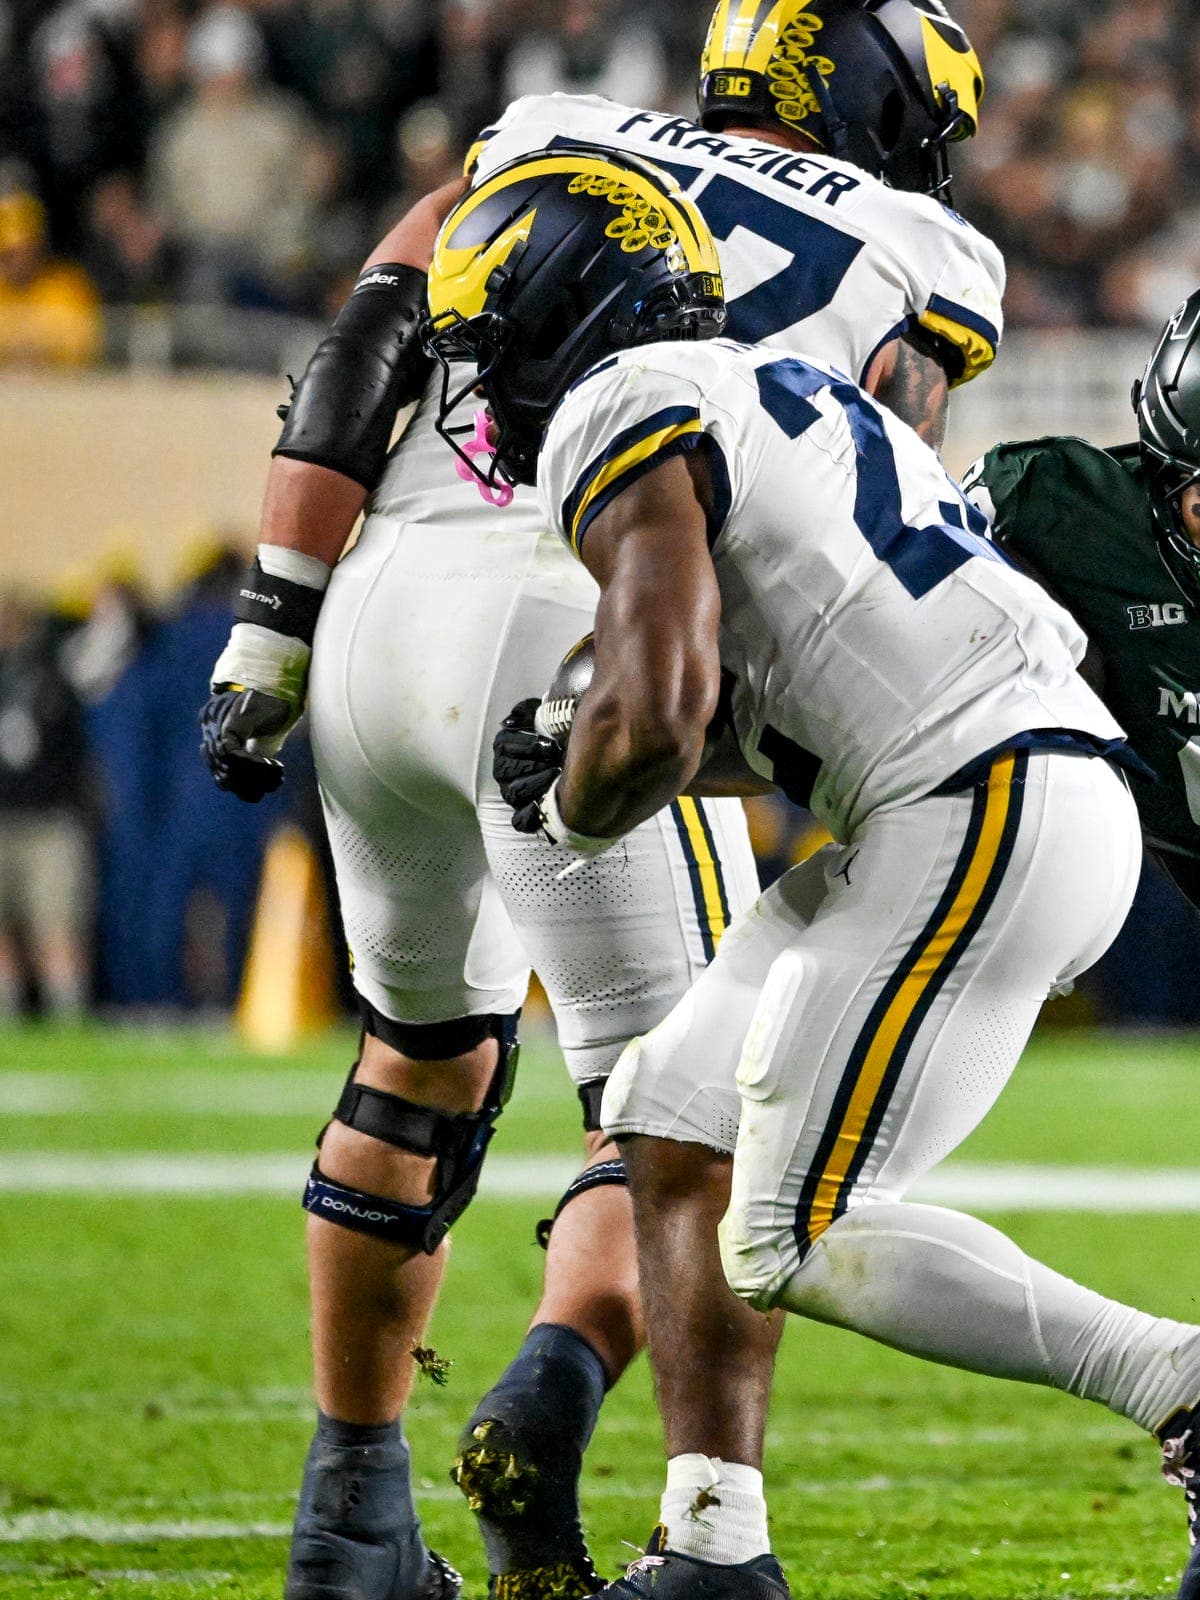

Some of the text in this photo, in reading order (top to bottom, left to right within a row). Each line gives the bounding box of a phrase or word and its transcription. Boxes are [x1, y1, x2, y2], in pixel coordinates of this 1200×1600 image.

[616, 111, 861, 206] FRAZIER
[546, 135, 866, 346] 7
[321, 1196, 399, 1223] DONJOY
